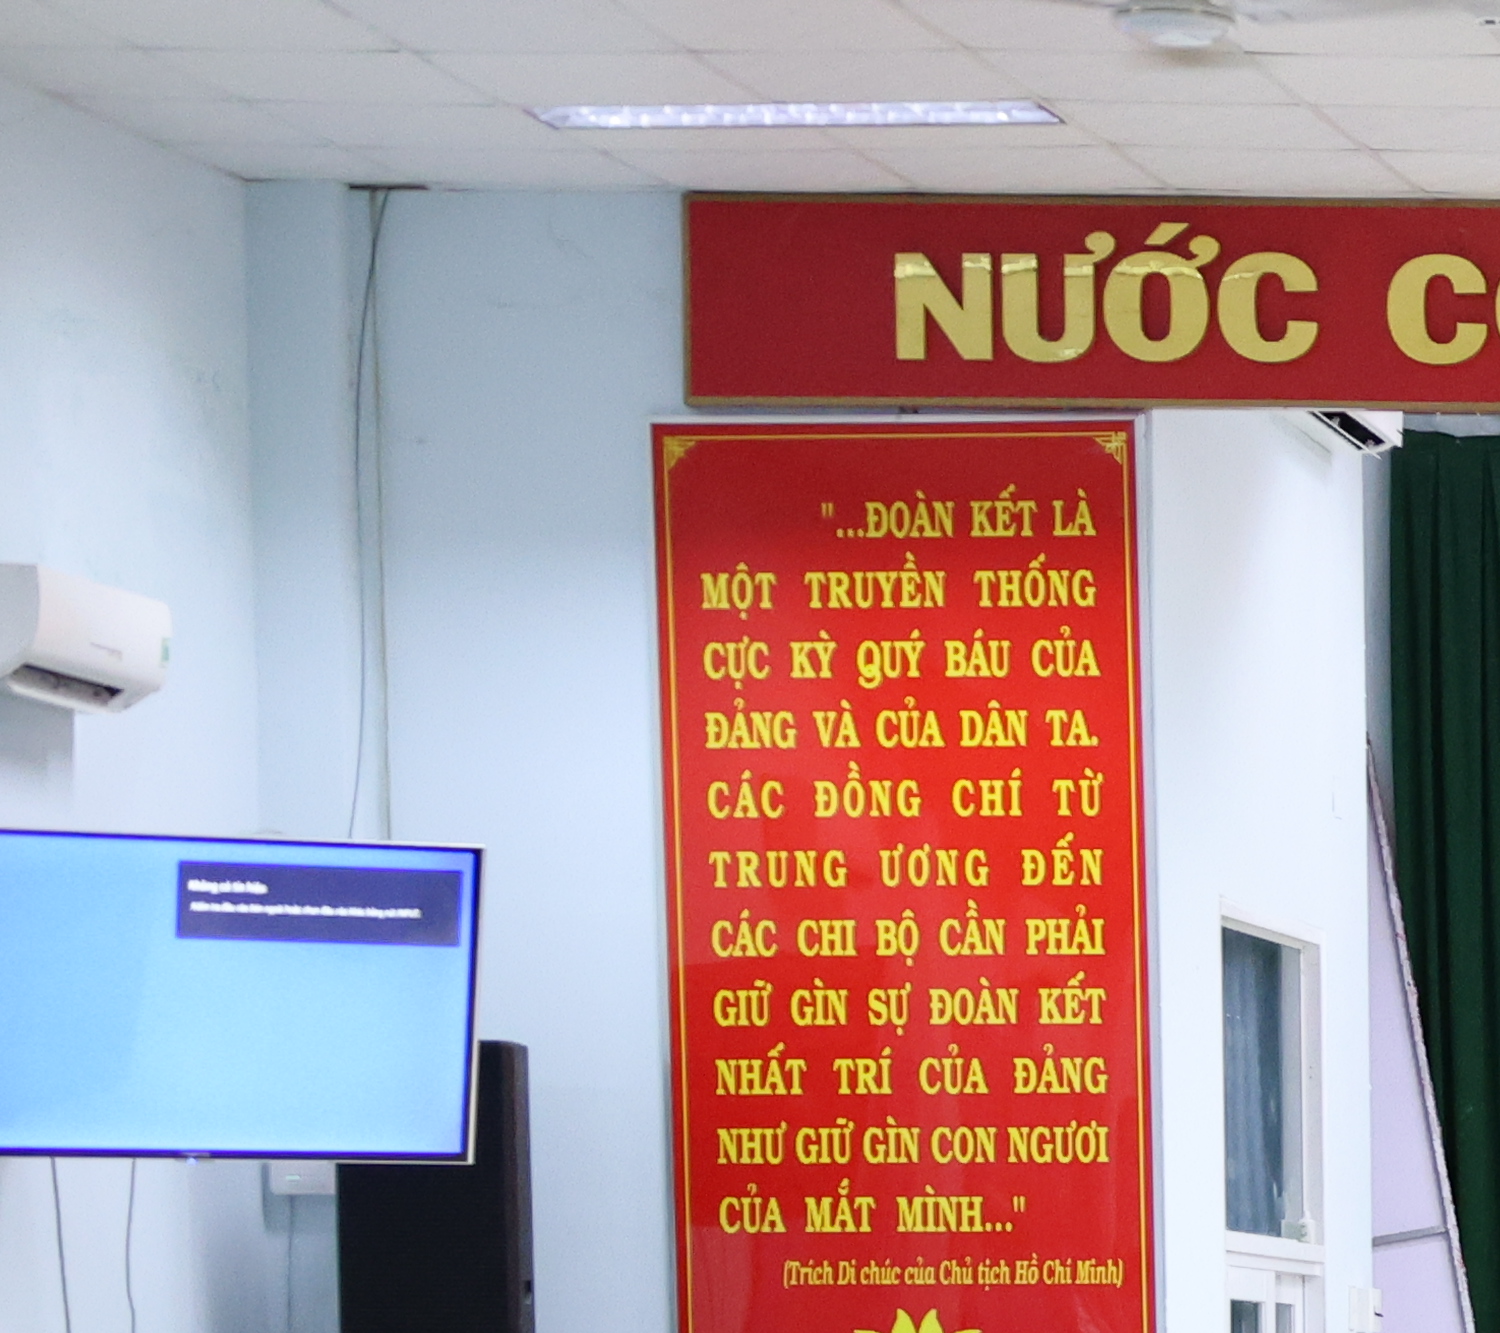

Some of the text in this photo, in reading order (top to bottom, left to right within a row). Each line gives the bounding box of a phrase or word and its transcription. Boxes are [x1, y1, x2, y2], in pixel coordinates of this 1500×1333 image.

[893, 222, 1319, 363] NƯỚC
[820, 484, 1097, 539] "...ĐOÀN KẾT LÀ
[700, 551, 1097, 621] MỘT TRUYỀN THỐNG
[703, 625, 1101, 690] CỰC KỲ QUÝ BÁU CỦA
[704, 695, 1100, 750] ĐẢNG VÀ CỦA DÂN TA.
[715, 1041, 1109, 1096] NHẤT TRÍ CỦA ĐẢNG
[717, 1115, 1110, 1165] NHƯ GIỮ GÌN CON NGƯƠI
[719, 1178, 1026, 1234] CỦA MẮT MÌNH..."
[783, 1252, 1124, 1291] (Trích Di chúc của Chủ tịch Hồ Chí Minh)
